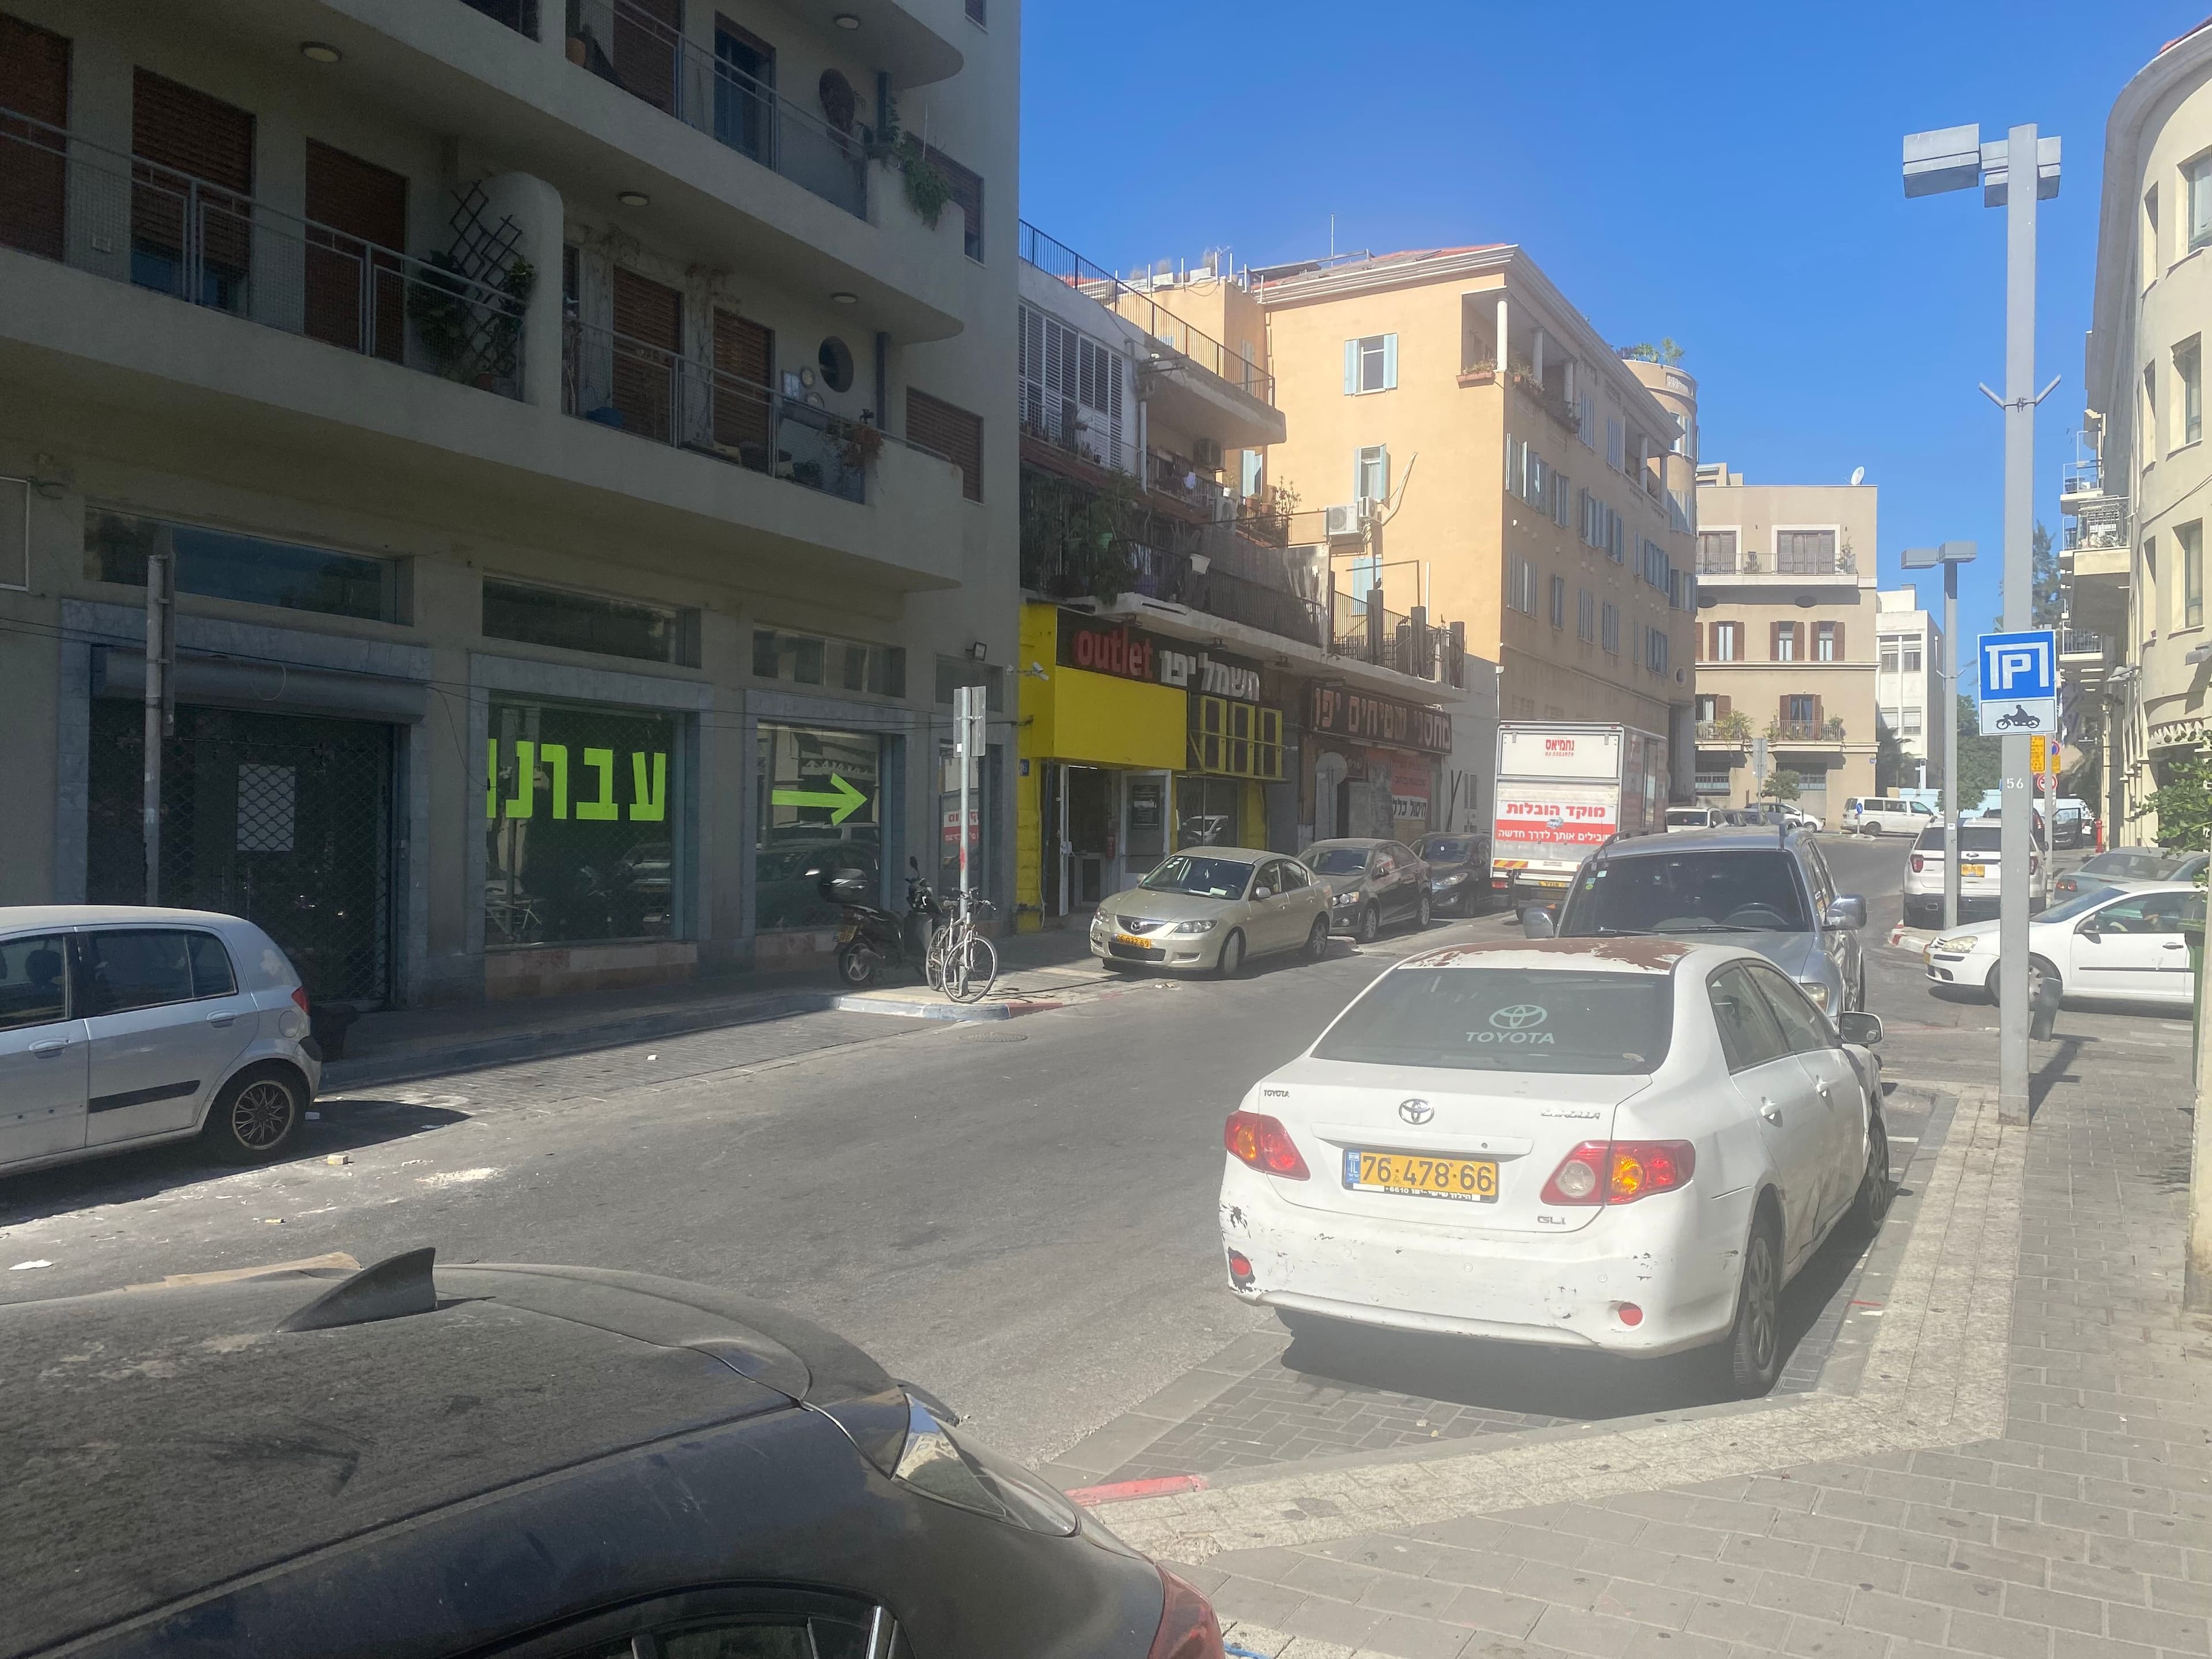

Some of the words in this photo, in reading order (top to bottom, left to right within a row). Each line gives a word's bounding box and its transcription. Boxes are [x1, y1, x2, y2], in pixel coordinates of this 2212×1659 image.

[1075, 627, 1153, 679] outlet
[1159, 650, 1196, 686] יפו
[2002, 654, 2031, 690] P
[1198, 652, 1260, 701] חשמל
[1315, 688, 1340, 728] יפו
[1348, 696, 1407, 740] שטיחים
[1546, 739, 1574, 751] נחמיאס
[2006, 778, 2024, 789] 56
[1392, 797, 1407, 816] כלל
[1506, 802, 1560, 816] הובלות
[1566, 805, 1605, 819] מוקד
[1498, 828, 1525, 838] חדשה
[1528, 830, 1550, 840] לדרך
[1554, 832, 1575, 841] אותך
[1466, 1032, 1555, 1044] TOYOTA
[1264, 1089, 1290, 1097] TOYOTA
